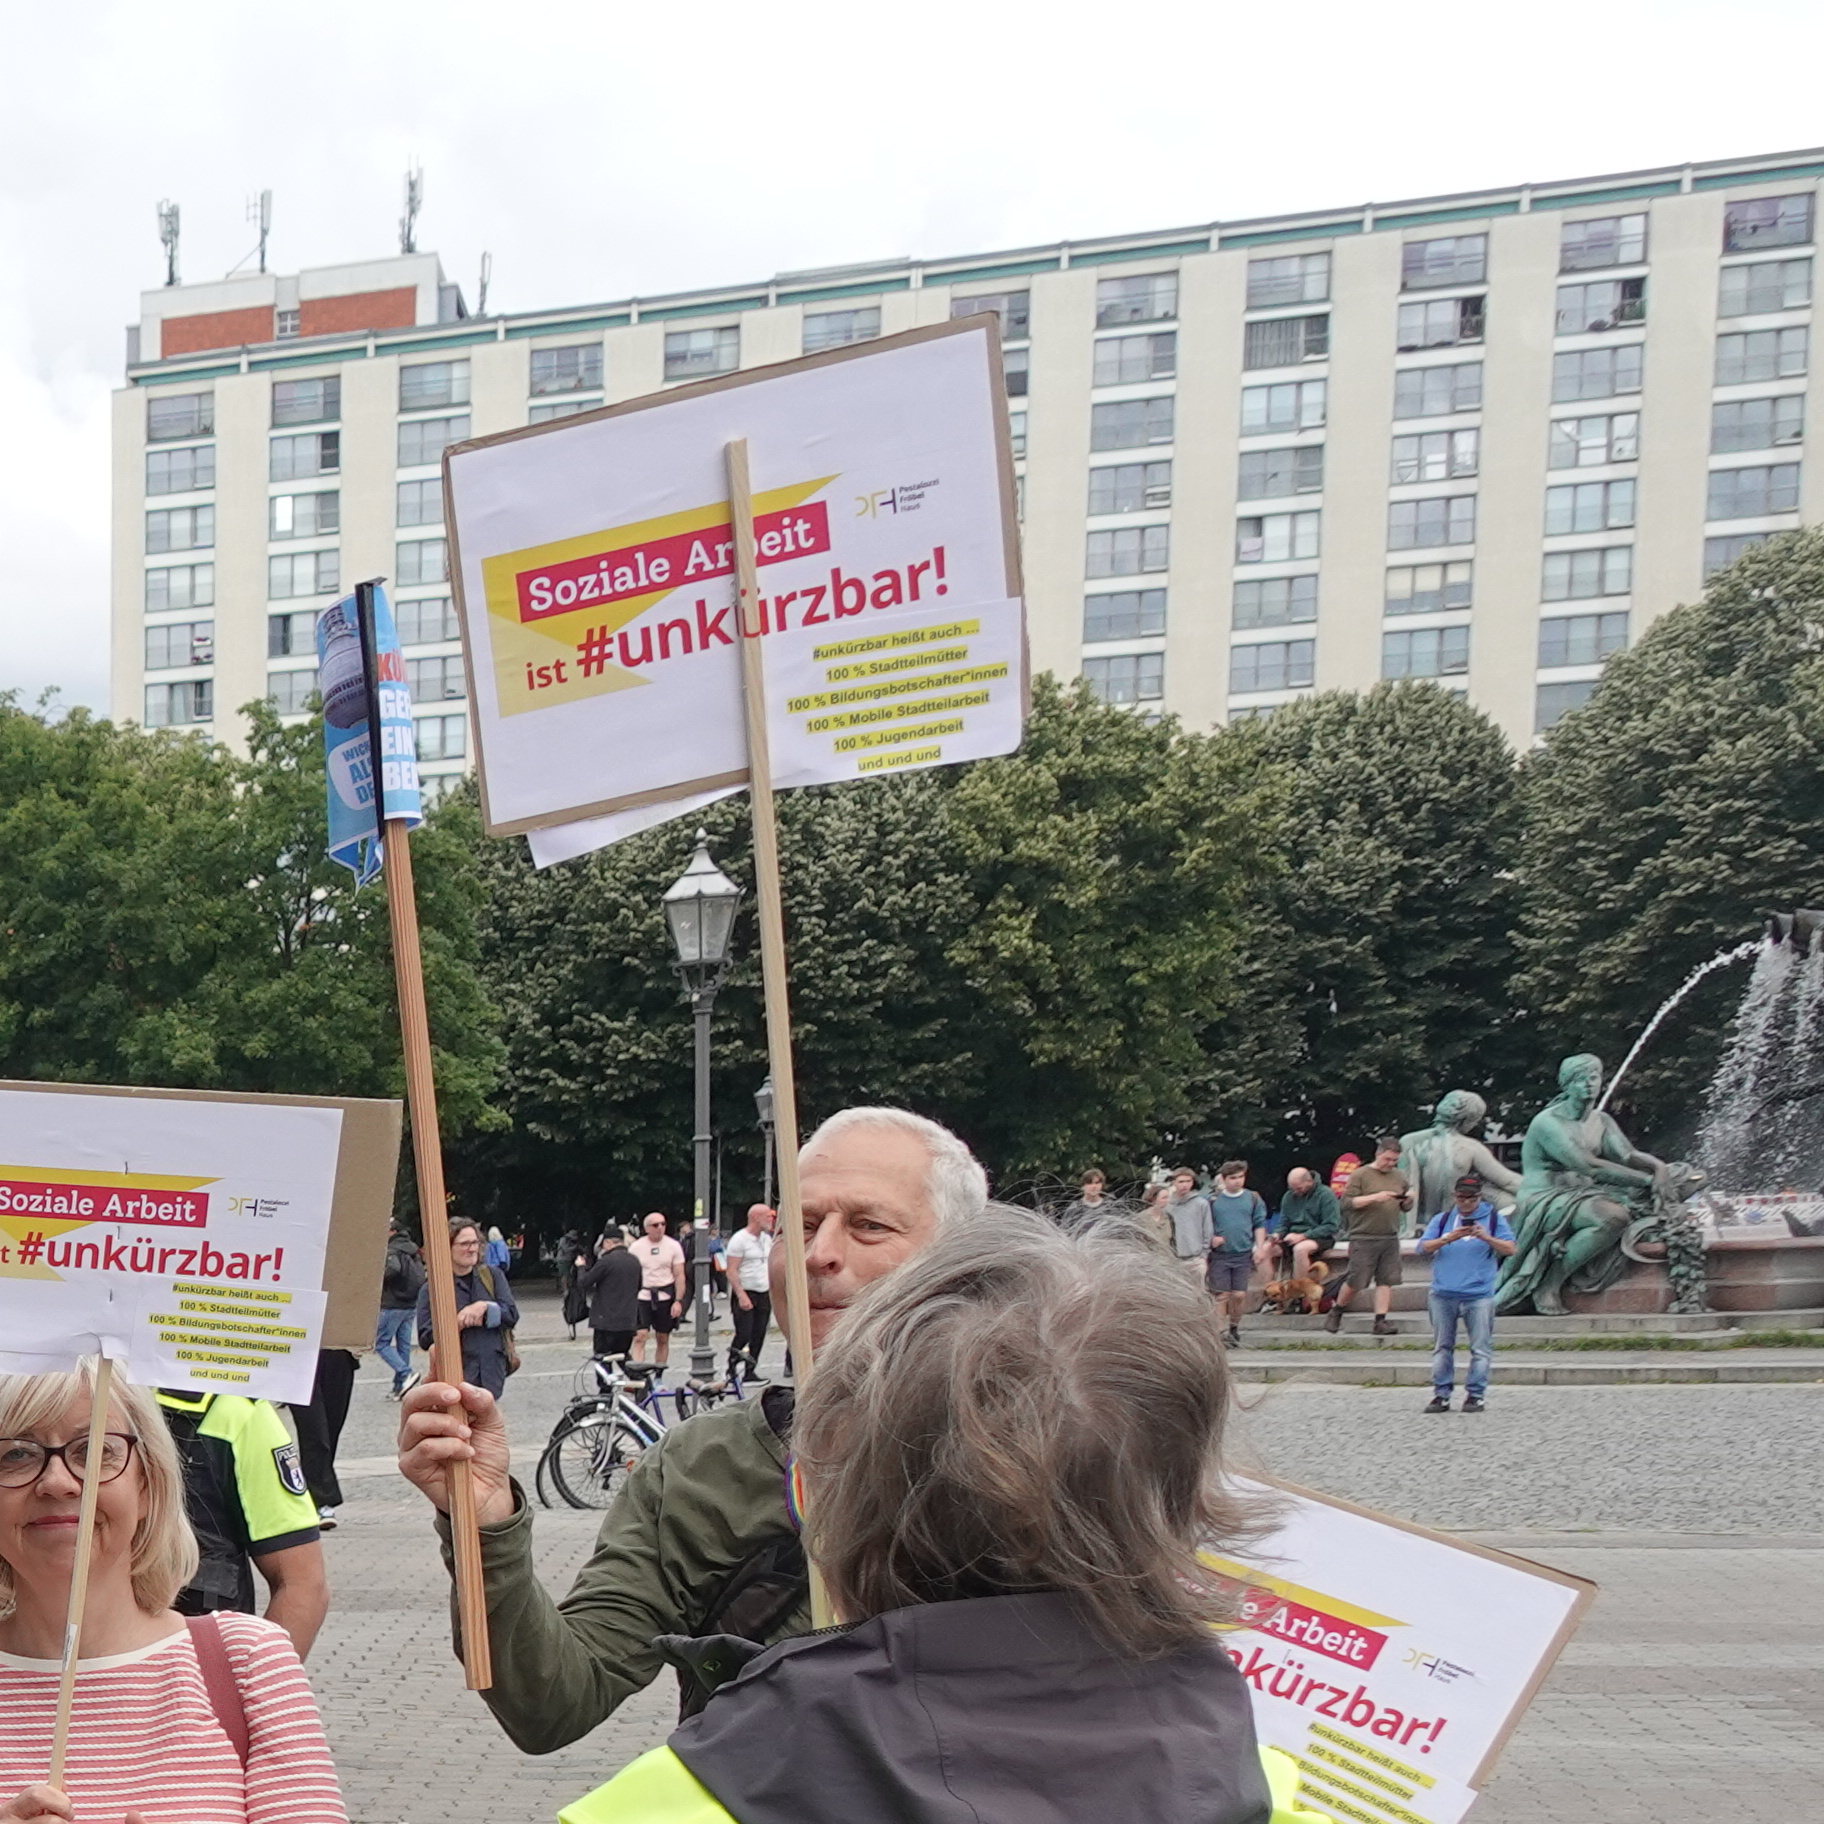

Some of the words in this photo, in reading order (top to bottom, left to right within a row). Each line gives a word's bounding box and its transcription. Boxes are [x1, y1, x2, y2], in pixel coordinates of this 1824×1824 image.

[529, 552, 670, 611] Soziale
[685, 517, 814, 576] Areit
[526, 659, 569, 690] ist
[576, 545, 948, 678] #unkürzbar!
[812, 638, 888, 659] #unkürzbar
[891, 630, 925, 646] heißt
[928, 624, 962, 640] auch
[826, 666, 849, 681] 100
[852, 664, 866, 676] %
[787, 697, 810, 712] 100
[813, 695, 826, 707] %
[806, 717, 829, 732] 100
[832, 715, 846, 727] %
[848, 708, 893, 725] Mobile
[833, 736, 856, 751] 100
[859, 735, 872, 746] %
[875, 719, 964, 744] Jugendarbeit
[857, 756, 883, 771] und
[886, 751, 912, 766] und
[915, 746, 941, 761] und
[103, 1195, 195, 1221] Arbeit
[17, 1232, 283, 1281] #unkürzbar!
[172, 1283, 227, 1296] #unkürzbar
[228, 1288, 253, 1299] heißt
[254, 1292, 279, 1302] auch
[179, 1300, 196, 1310] 100
[198, 1302, 208, 1312] %
[149, 1314, 166, 1324] 100
[167, 1315, 177, 1325] %
[159, 1331, 176, 1342] 100
[178, 1333, 188, 1343] %
[189, 1334, 221, 1346] Mobile
[176, 1350, 193, 1360] 100
[194, 1351, 204, 1361] %
[205, 1353, 269, 1368] Jugendarbeit
[189, 1369, 209, 1378] und
[210, 1371, 229, 1380] und
[230, 1373, 250, 1382] und
[1262, 1607, 1367, 1661] Arbeit
